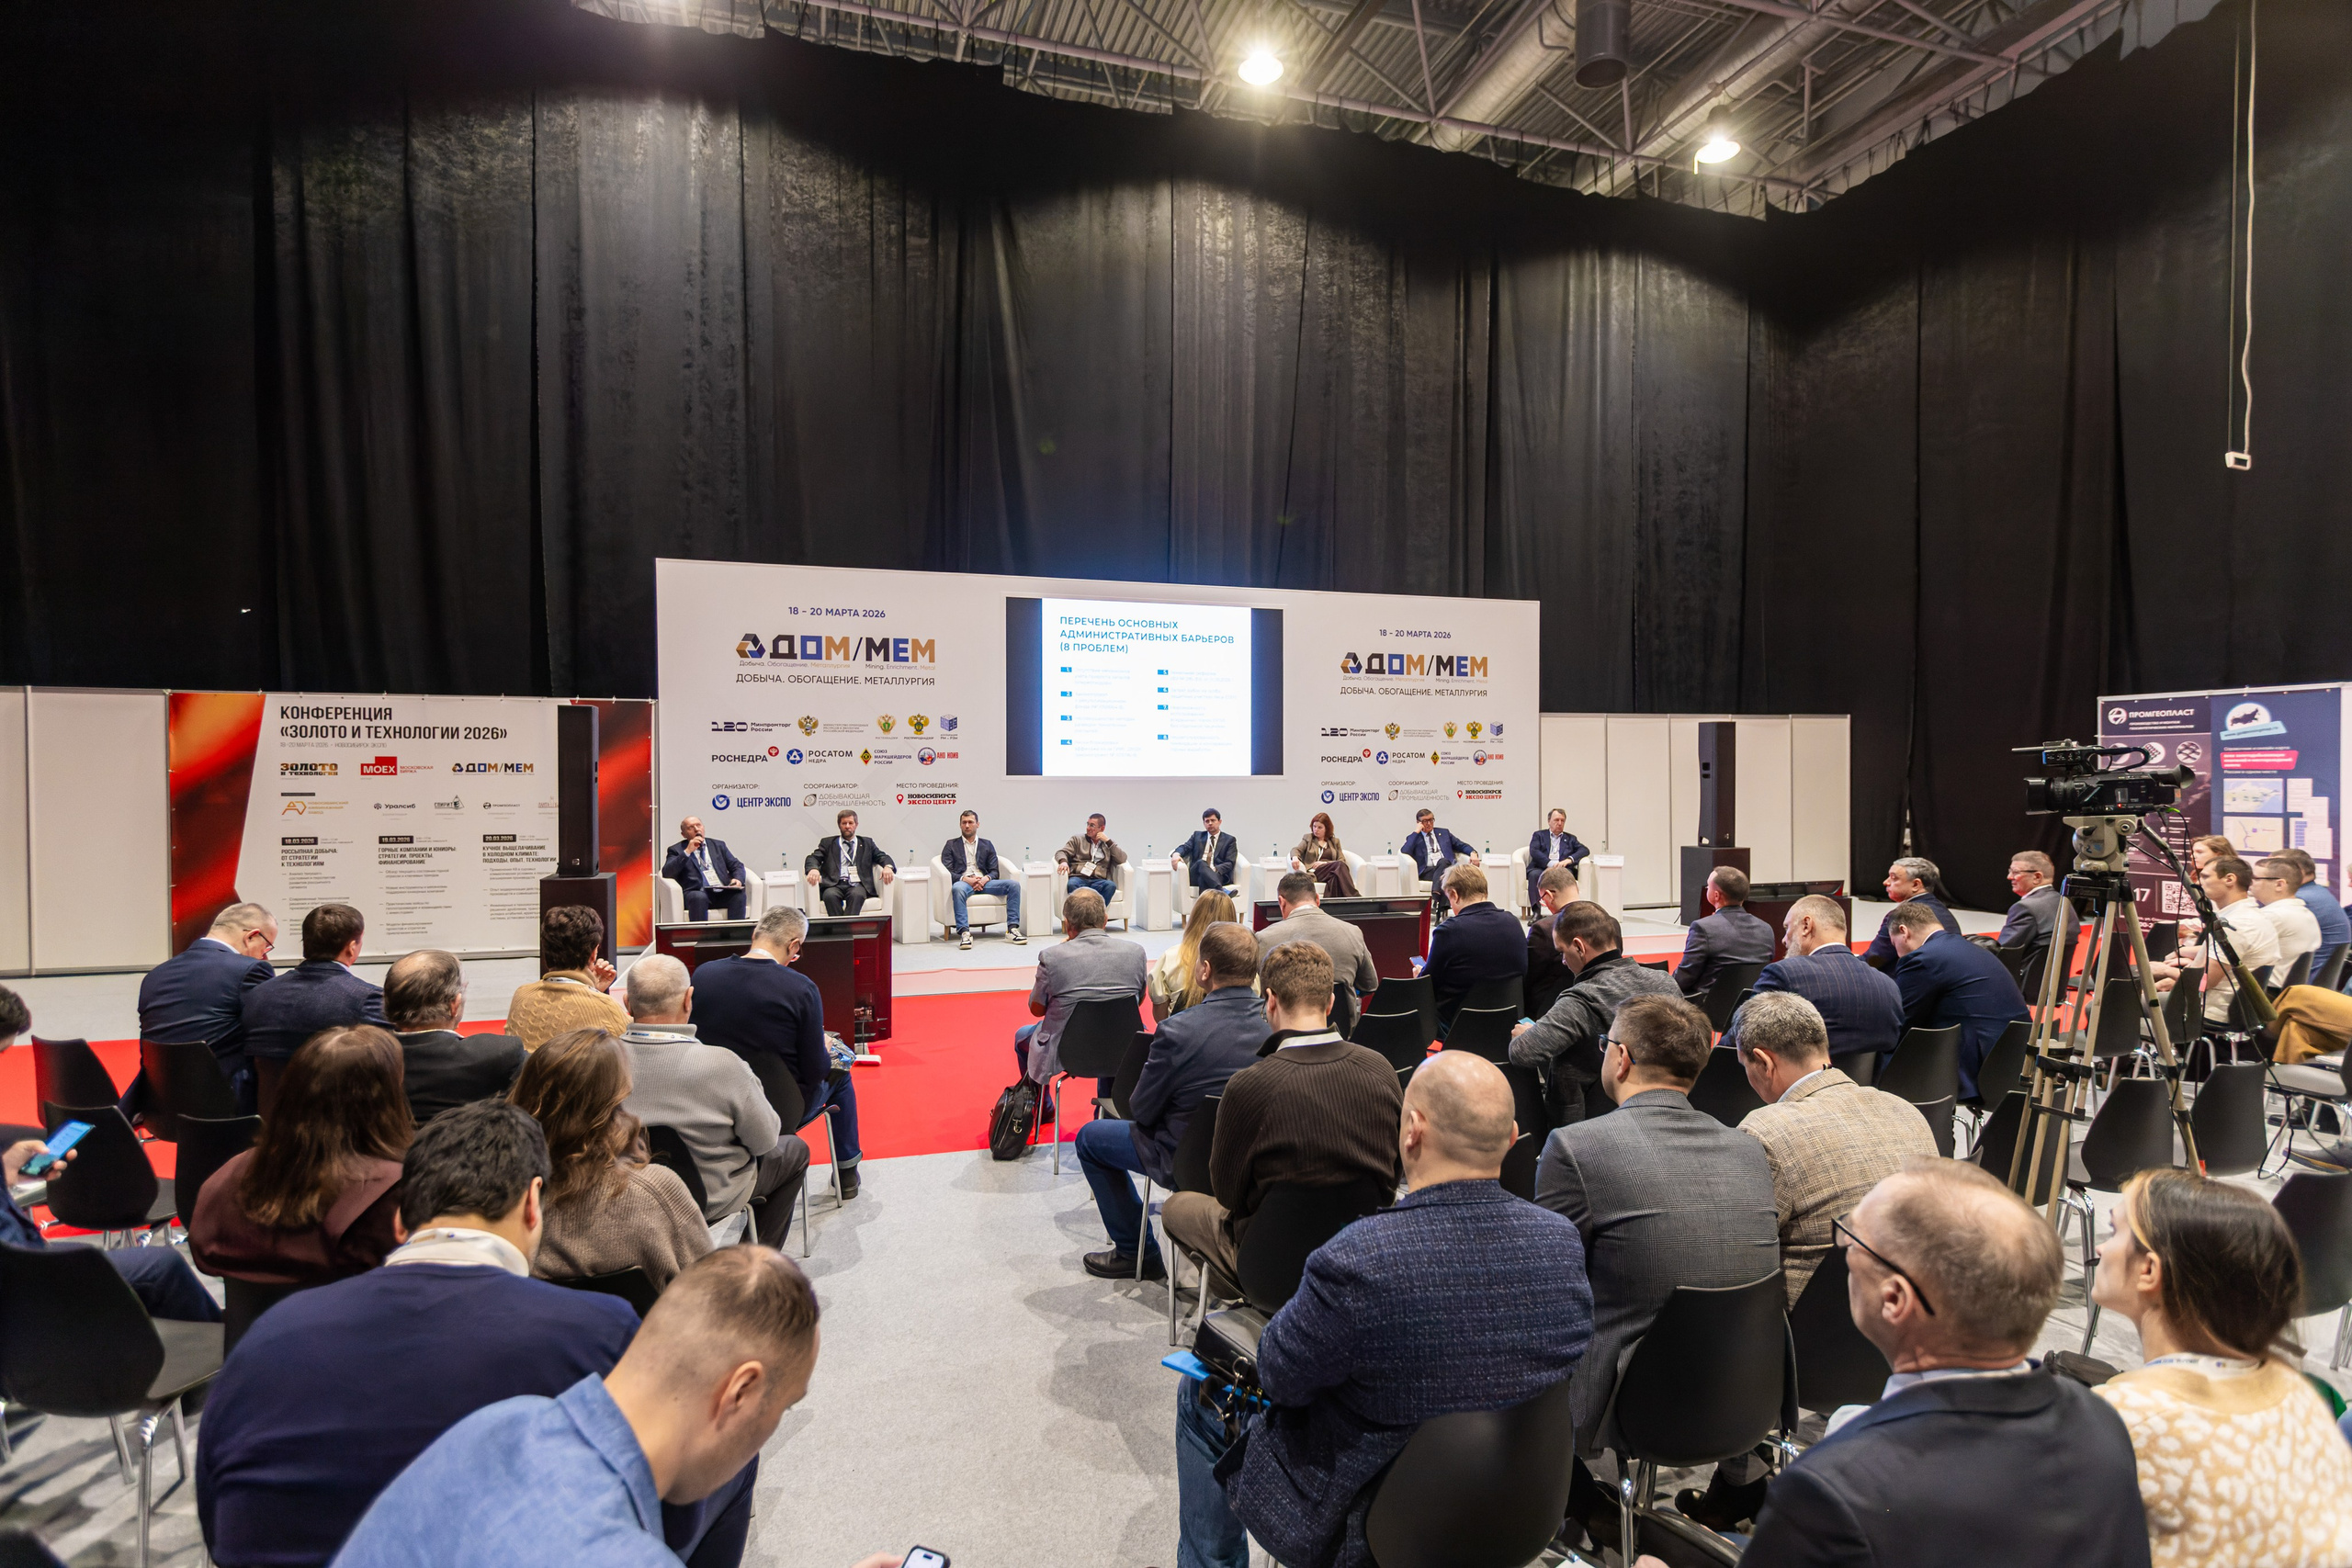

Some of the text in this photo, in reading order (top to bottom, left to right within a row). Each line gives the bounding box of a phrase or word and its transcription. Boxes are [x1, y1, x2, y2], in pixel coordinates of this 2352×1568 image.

[788, 606, 798, 615] 18
[810, 607, 822, 615] 20
[825, 608, 860, 617] МАРТА
[863, 609, 886, 618] 2026
[1060, 616, 1179, 629] ПЕРЕЧЕНЬ ОСНОВНЫХ
[1060, 630, 1235, 644] АДМИНИСТРАТИВНЫХ БАРЬЕРОВ
[1407, 630, 1431, 638] МАРТА
[1060, 642, 1128, 654] (8 ПРОБЛЕМ)
[736, 674, 935, 685] ДОБЫЧА. ОБОГАЩЕНИЕ. МЕТАЛЛУРГИЯ
[1340, 686, 1487, 697] ДОБЫЧА. ОБОГАЩЕНИЕ. МЕТАЛЛУРГИЯ
[281, 705, 392, 722] КОНФЕРЕНЦИЯ
[2129, 709, 2195, 718] ПРОМГЕОПЛАСТ
[280, 725, 507, 740] «ЗОЛОТО И ТЕХНОЛОГИИ 2026»
[711, 754, 768, 764] РОСНЕДРА
[1321, 756, 1363, 764] РОСНЕДРА
[280, 762, 338, 771] ЗОЛОТО
[363, 765, 396, 773] MOEX
[737, 796, 791, 808] ЦЕНТР ЭКСПО
[1339, 793, 1380, 802] ЦЕНТР ЭКСПО
[2133, 887, 2151, 902] 17
